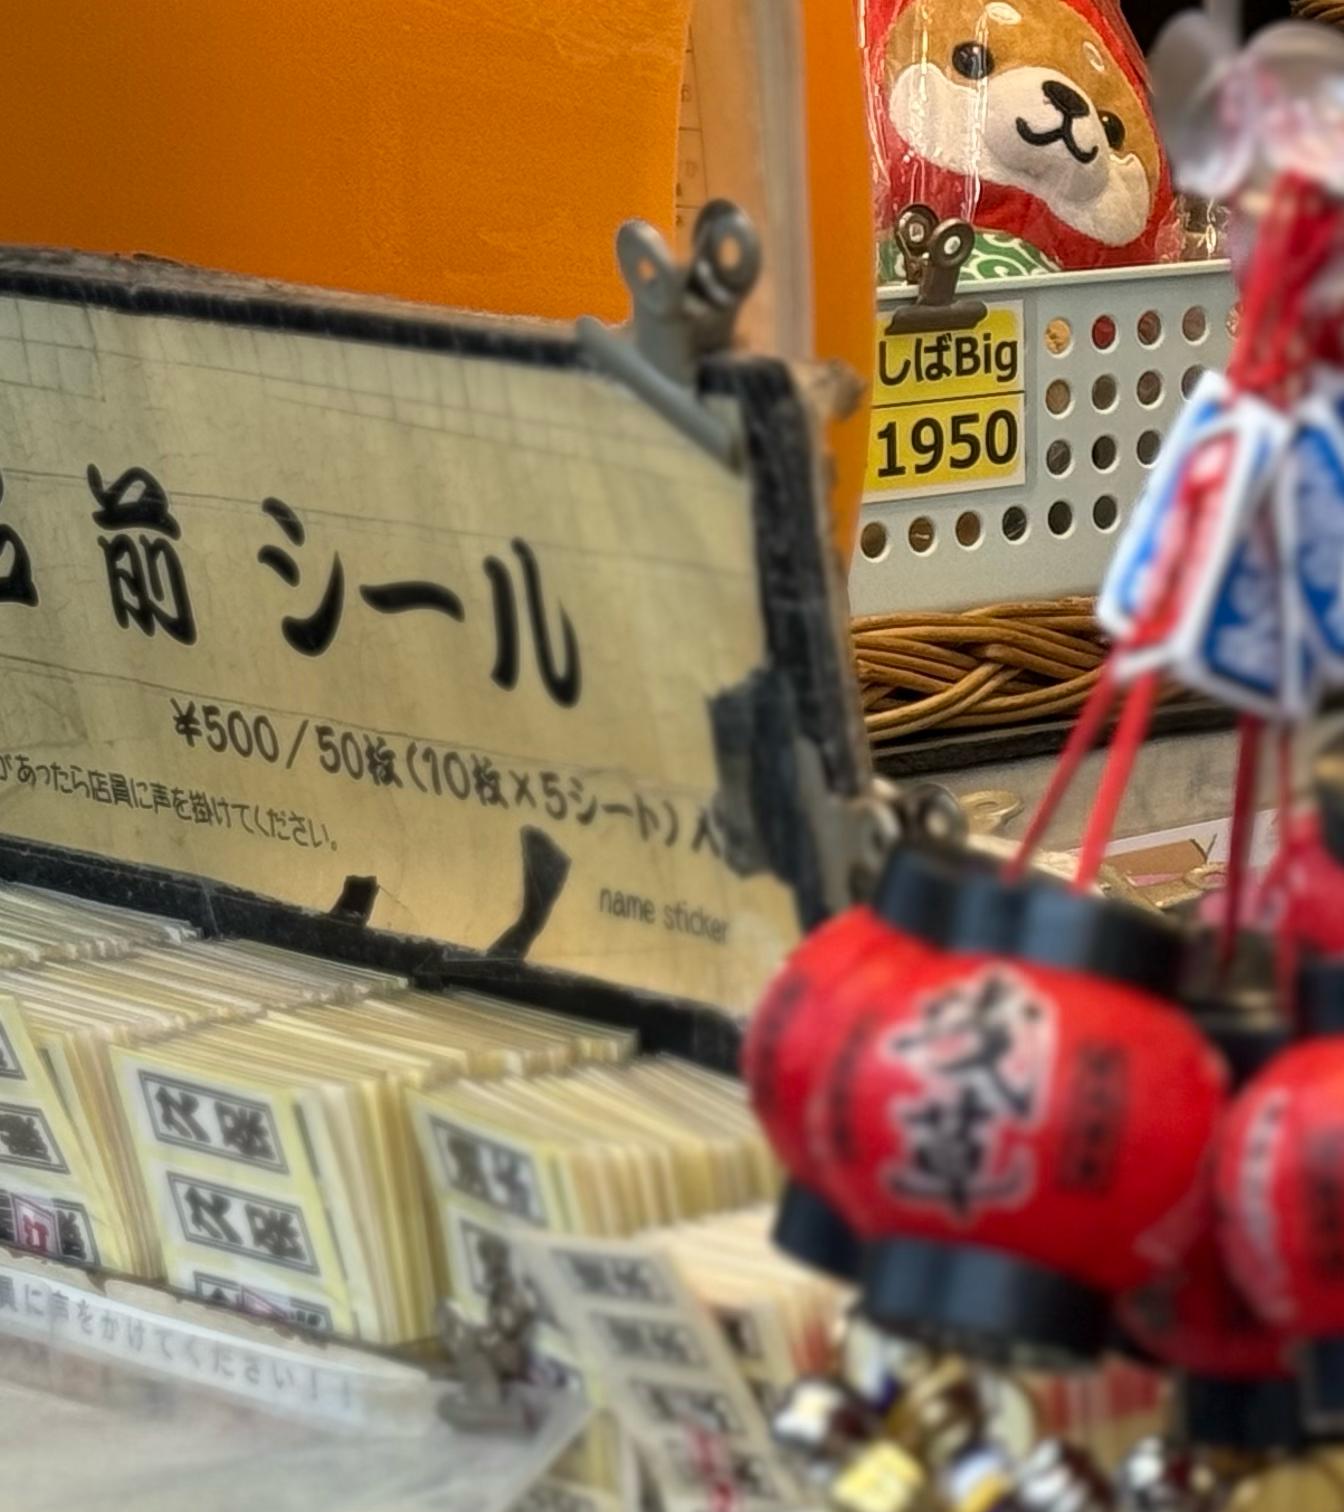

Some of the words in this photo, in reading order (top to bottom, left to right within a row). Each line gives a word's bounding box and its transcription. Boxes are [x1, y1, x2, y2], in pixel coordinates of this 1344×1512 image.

[878, 330, 1020, 386] しばBig
[875, 409, 1019, 478] 1950
[598, 886, 656, 927] name
[661, 896, 731, 944] sticker
